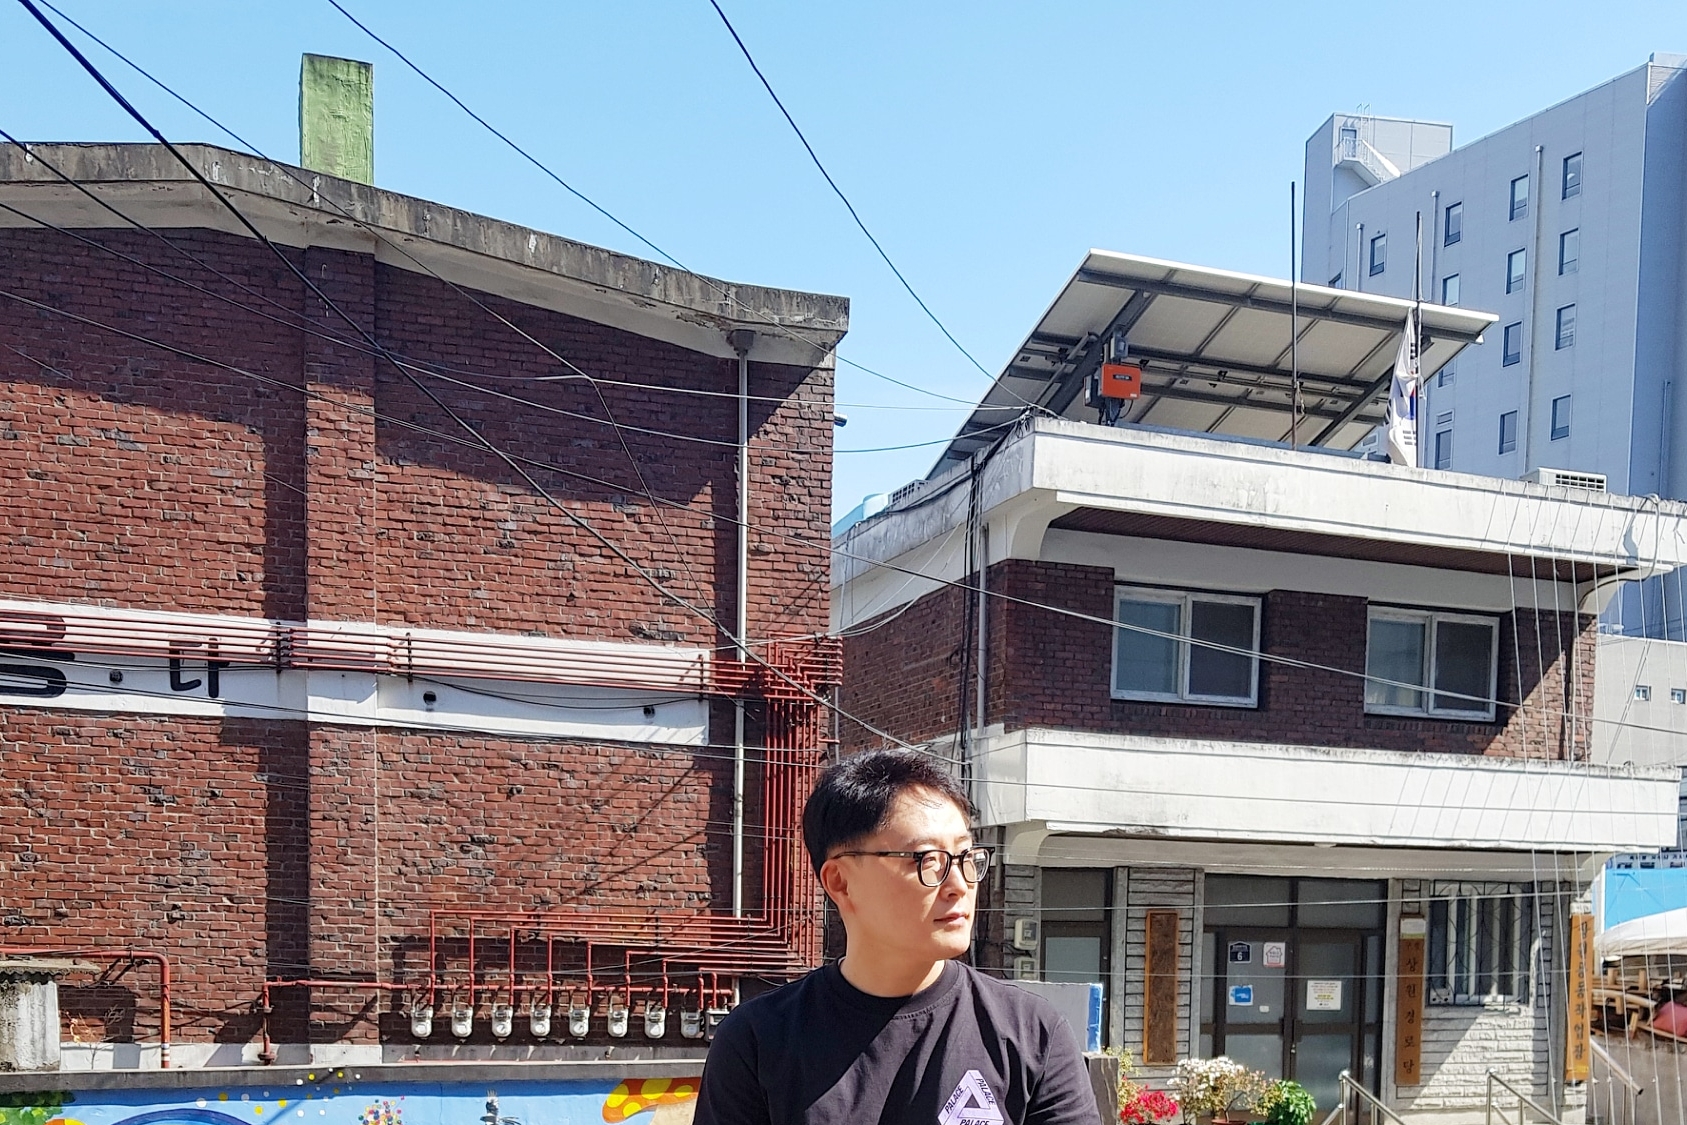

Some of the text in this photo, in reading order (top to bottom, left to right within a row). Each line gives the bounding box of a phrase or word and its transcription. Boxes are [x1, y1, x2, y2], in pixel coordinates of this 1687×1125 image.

[1237, 952, 1243, 961] 6
[944, 1085, 964, 1114] PALACE
[975, 1078, 996, 1106] PALACE
